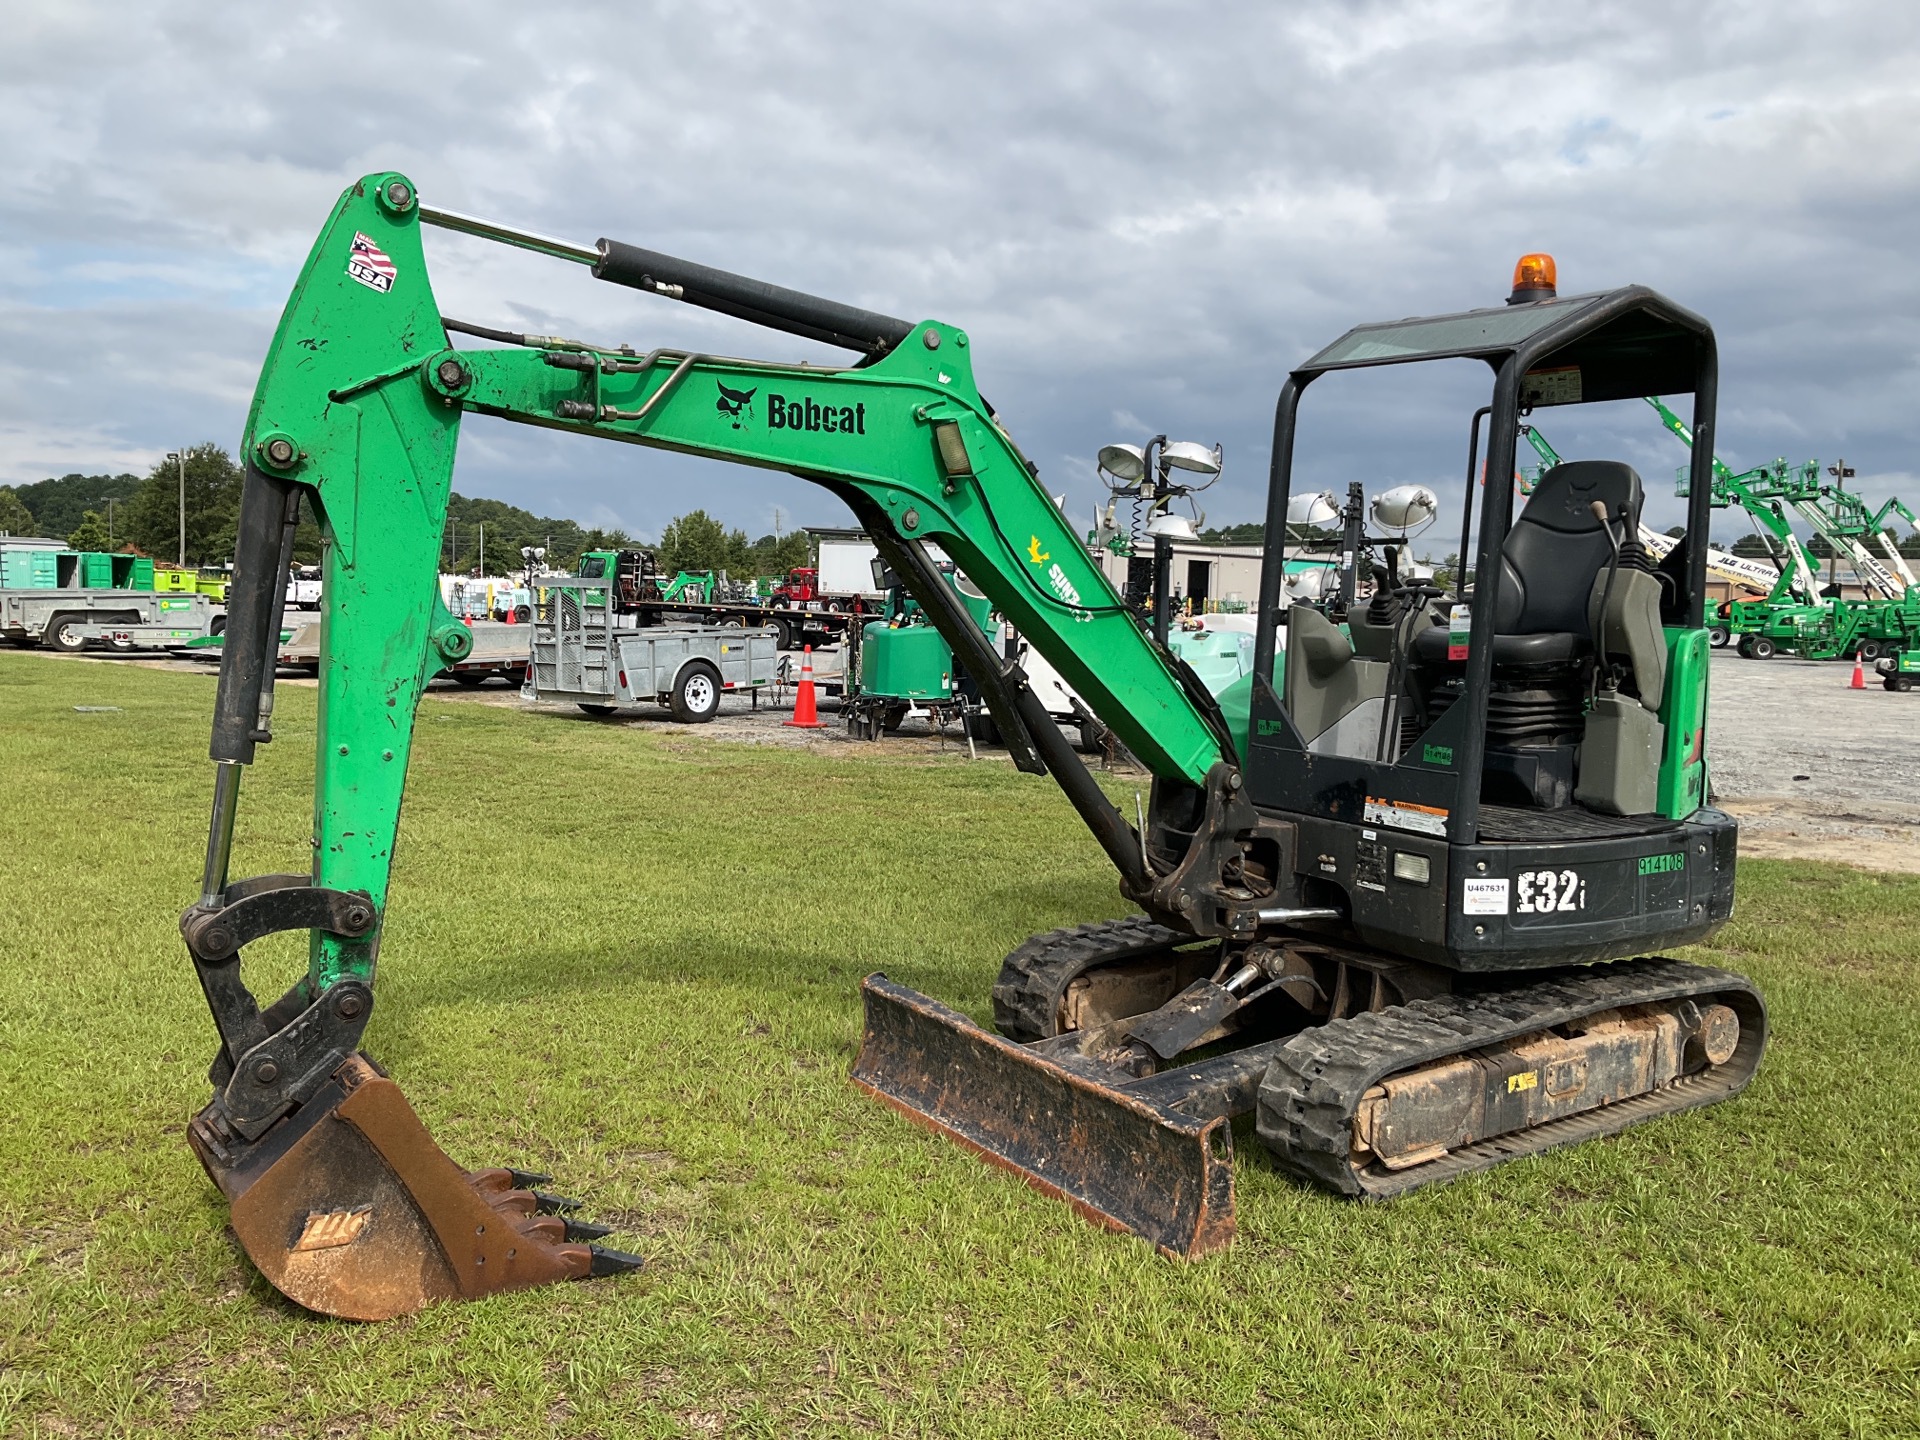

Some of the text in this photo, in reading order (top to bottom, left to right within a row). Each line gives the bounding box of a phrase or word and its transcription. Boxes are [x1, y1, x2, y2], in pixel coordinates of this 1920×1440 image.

[349, 262, 388, 290] USA
[767, 393, 865, 434] Bobcat
[1717, 557, 1738, 566] JLG
[1740, 563, 1774, 577] ULTRA
[1866, 557, 1893, 580] JLG LIFT
[1396, 802, 1421, 812] WARNING
[1639, 853, 1684, 874] 914108
[1467, 884, 1505, 892] U467631
